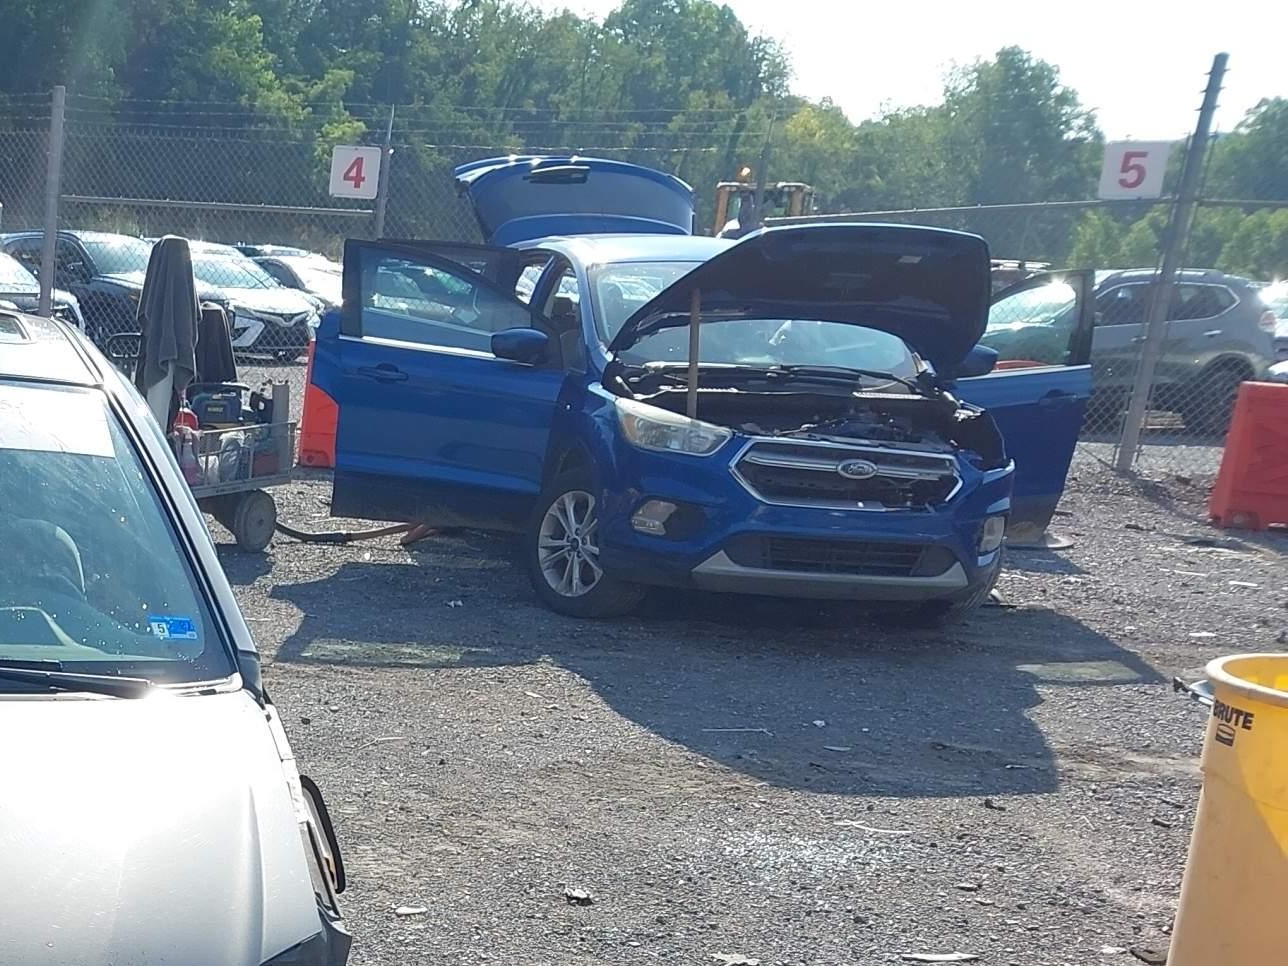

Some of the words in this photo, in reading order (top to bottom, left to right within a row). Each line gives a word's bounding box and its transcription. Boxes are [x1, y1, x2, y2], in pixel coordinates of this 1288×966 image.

[343, 156, 366, 189] 4
[1118, 151, 1149, 189] 5
[157, 623, 166, 634] 5
